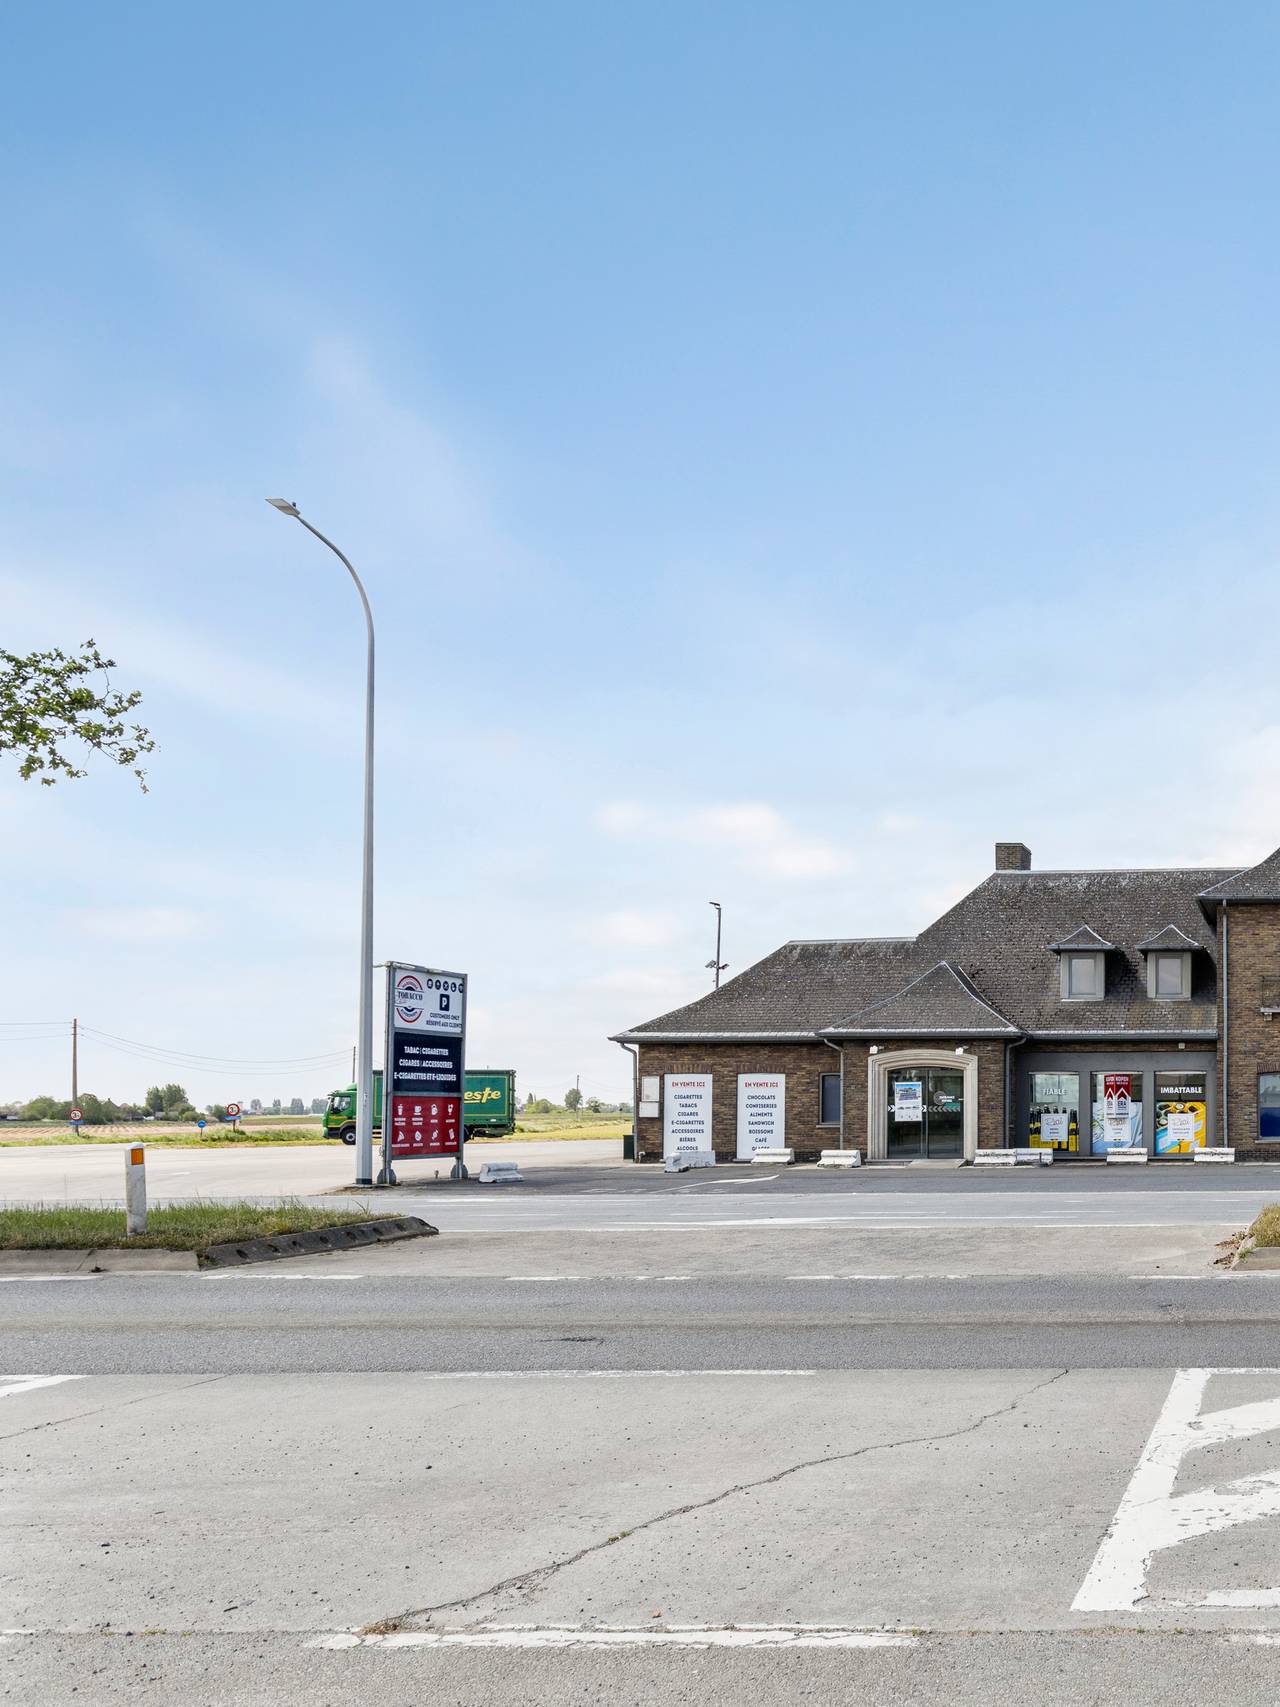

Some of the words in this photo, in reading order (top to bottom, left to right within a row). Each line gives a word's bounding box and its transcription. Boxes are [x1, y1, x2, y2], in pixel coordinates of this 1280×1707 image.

[441, 997, 448, 1008] P
[429, 1012, 451, 1020] CUSTOMERS
[404, 1046, 420, 1054] TABAC
[421, 1047, 449, 1056] CIGARETTES
[399, 1059, 420, 1067] CIGARES
[422, 1060, 453, 1069] ACCESSOIRES
[394, 1072, 426, 1080] E-CIGARETTES
[1160, 1086, 1203, 1094] IMBATTABLE
